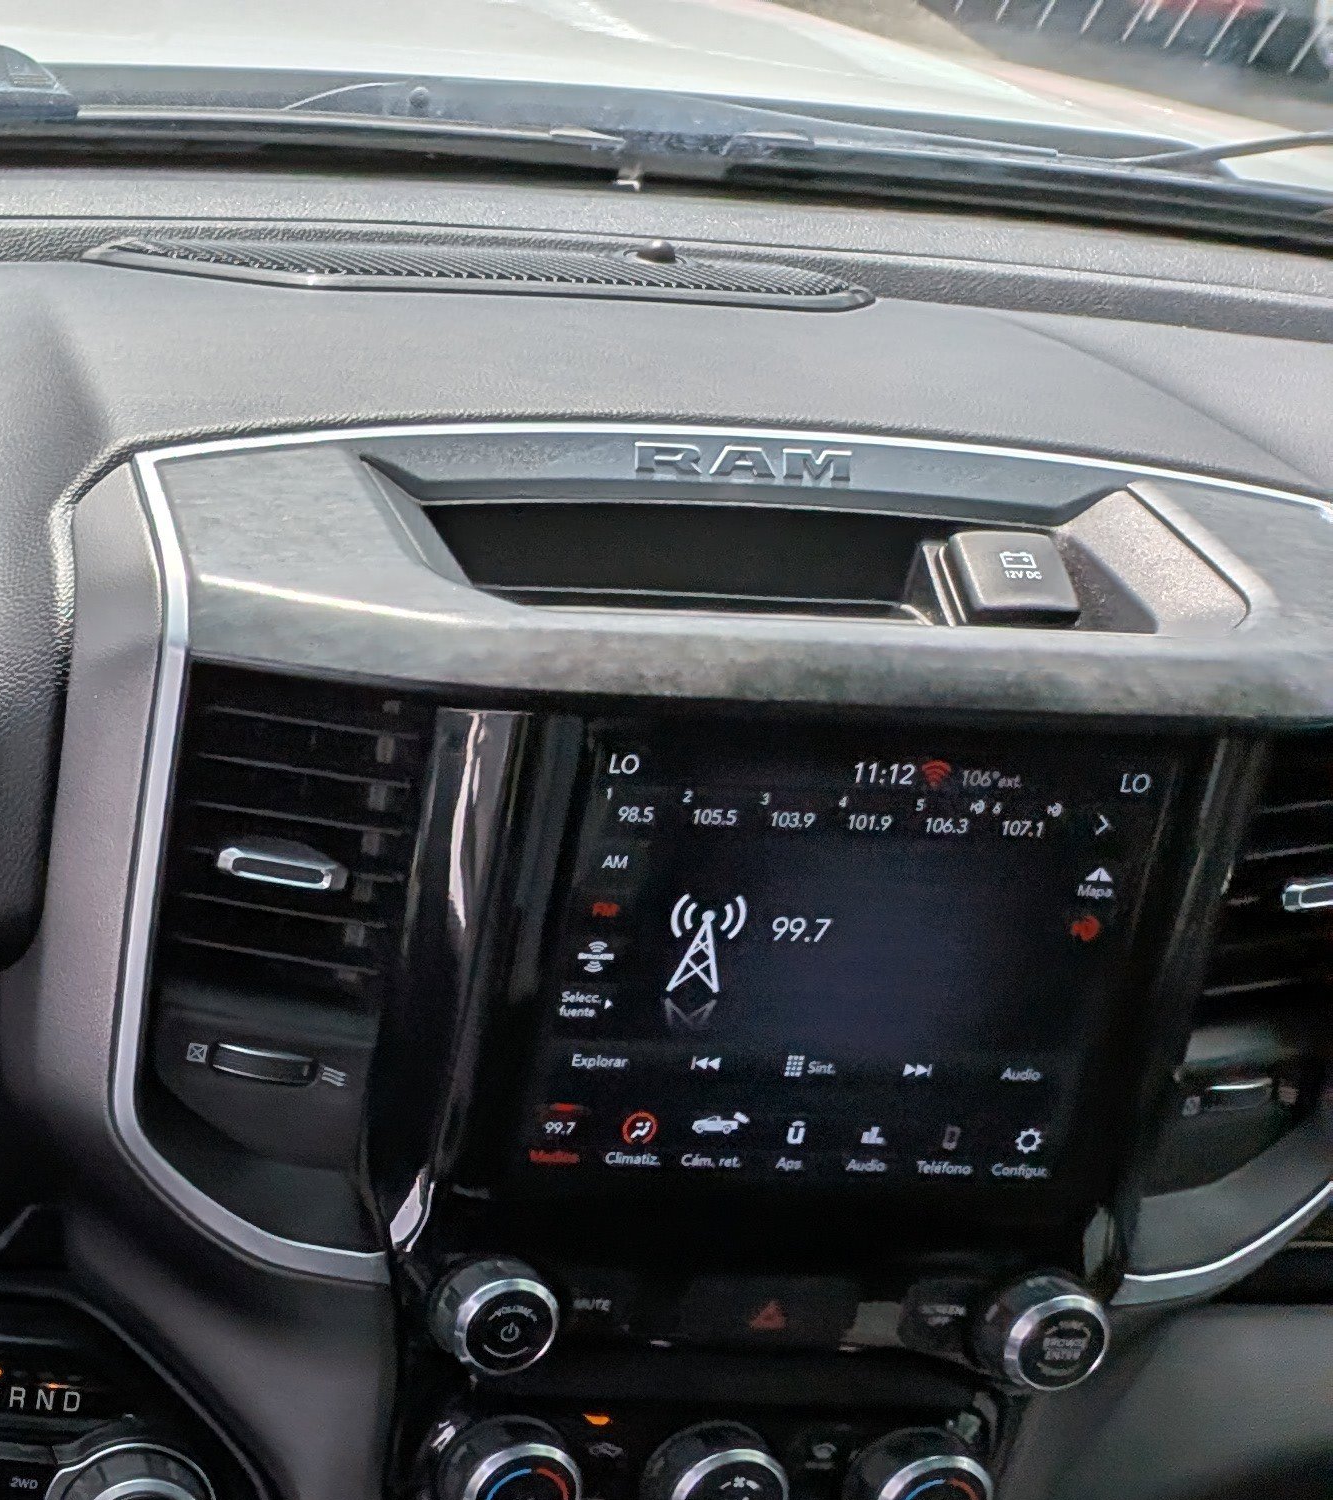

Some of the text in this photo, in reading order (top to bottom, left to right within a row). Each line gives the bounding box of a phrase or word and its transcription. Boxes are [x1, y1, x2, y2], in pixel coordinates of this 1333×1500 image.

[634, 440, 853, 482] RAM
[1004, 570, 1043, 580] 12V DC
[608, 753, 640, 775] LO
[854, 761, 916, 786] 11:12
[1119, 772, 1152, 795] LO
[606, 787, 614, 800] 1
[682, 788, 695, 803] 2
[759, 791, 772, 806] 3
[837, 796, 849, 808] 4
[915, 798, 926, 812] 5
[992, 801, 1002, 815] 6
[618, 805, 655, 823] 98.5
[692, 808, 738, 827] 105.5
[771, 811, 817, 829] 103.9
[847, 814, 894, 832] 101.9
[925, 816, 971, 835] 106.3
[1001, 818, 1046, 839] 107.1
[601, 854, 629, 870] AM
[770, 916, 832, 945] 99.7
[571, 1053, 630, 1071] Explorar
[1000, 1067, 1043, 1083] Audio
[544, 1121, 577, 1136] 99.7
[844, 1157, 888, 1173] Audio
[916, 1160, 974, 1177] Teléfono
[10, 1476, 39, 1490] 2WD
